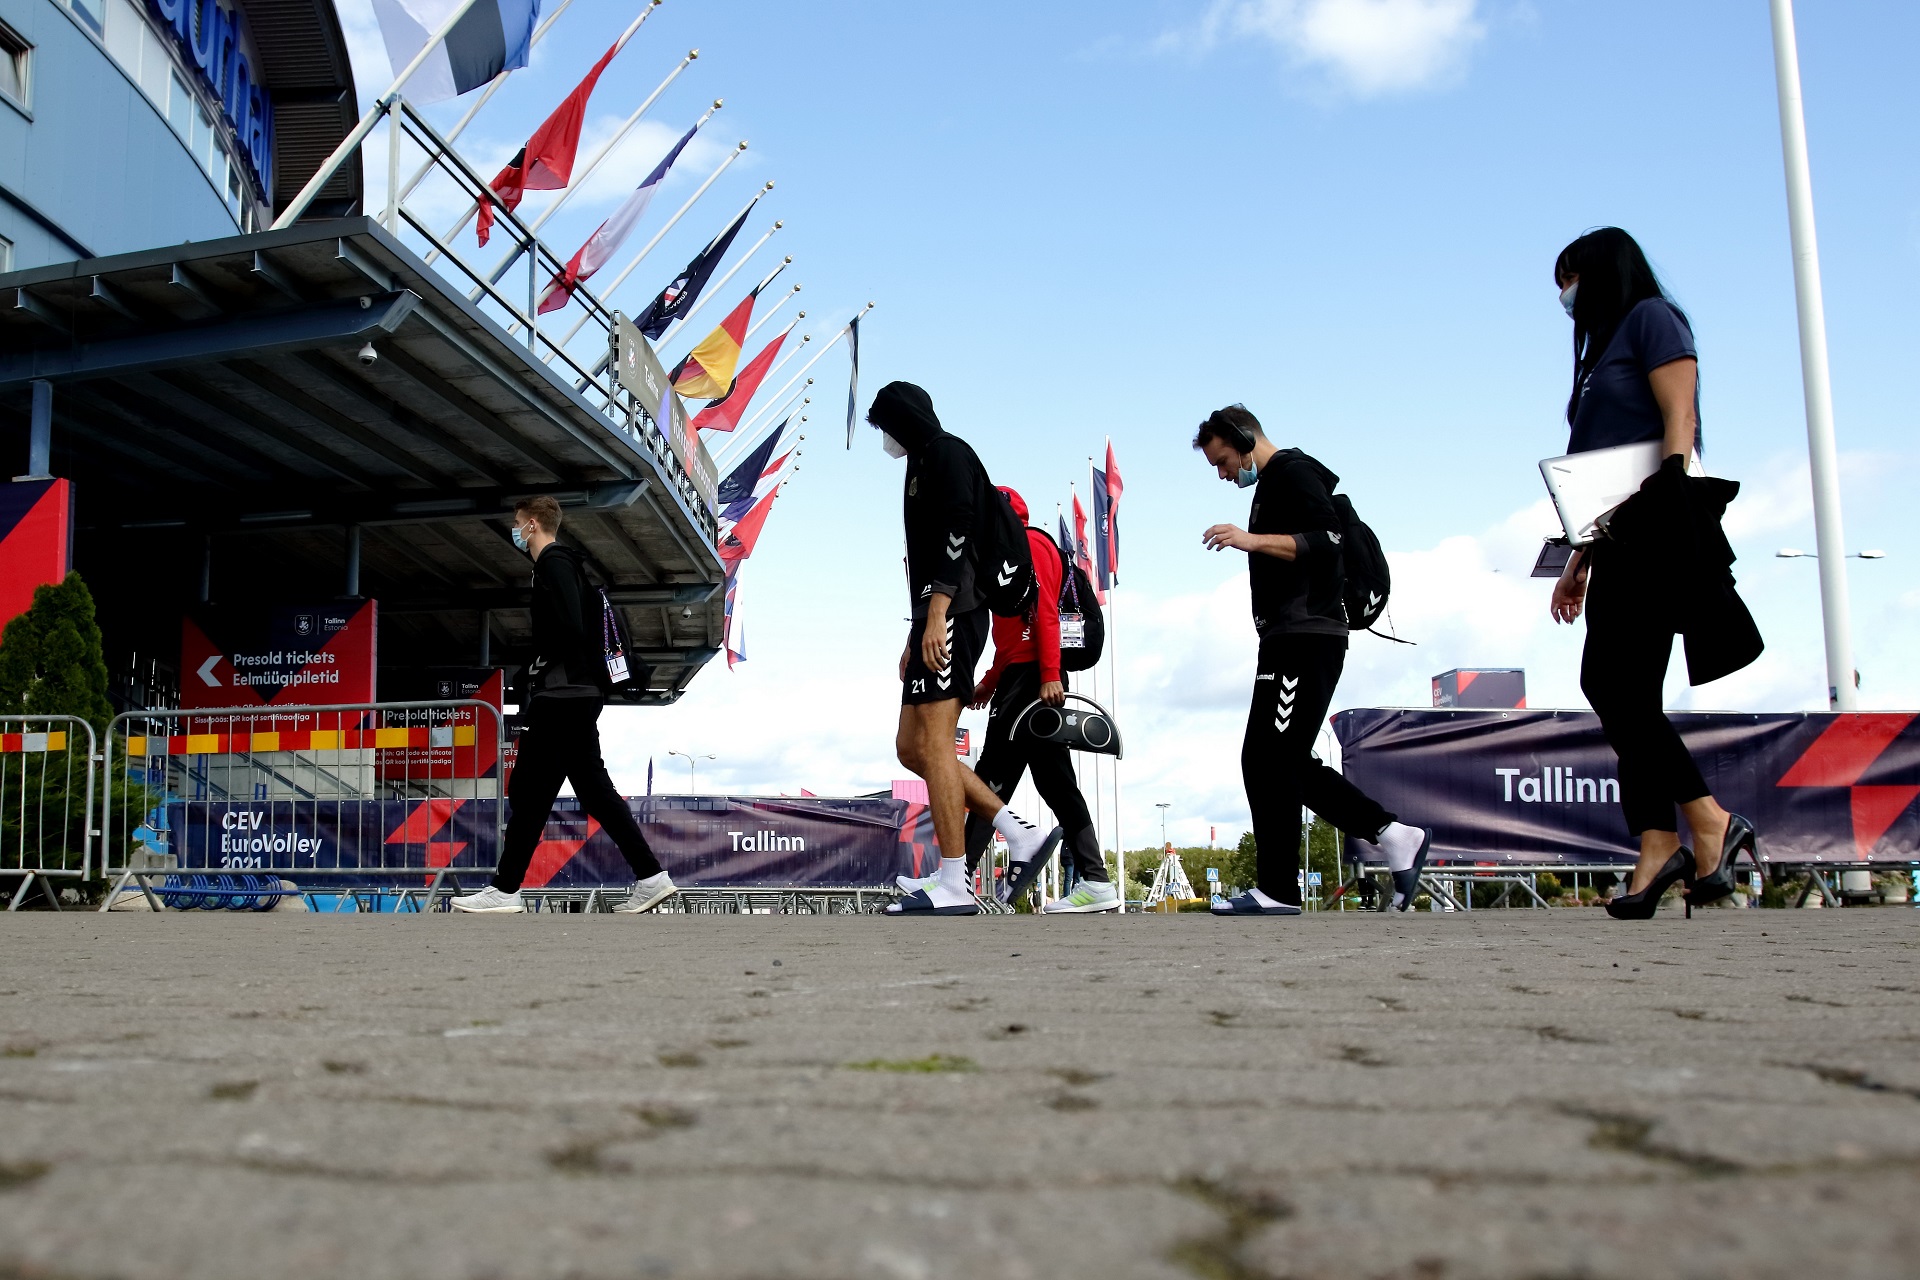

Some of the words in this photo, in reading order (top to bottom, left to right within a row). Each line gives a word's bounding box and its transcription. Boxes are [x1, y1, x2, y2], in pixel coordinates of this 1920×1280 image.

[233, 651, 282, 667] Presold
[286, 650, 335, 665] tickets
[233, 669, 339, 688] Eelmüügipiletid
[911, 678, 926, 694] 21
[1433, 687, 1443, 697] CEV
[260, 713, 310, 722] sertfikaadiga
[431, 709, 471, 720] tickets
[1495, 766, 1621, 803] Tallinn
[221, 811, 264, 830] CEV
[221, 832, 322, 858] EuroVolley
[727, 830, 805, 852] Tallinn
